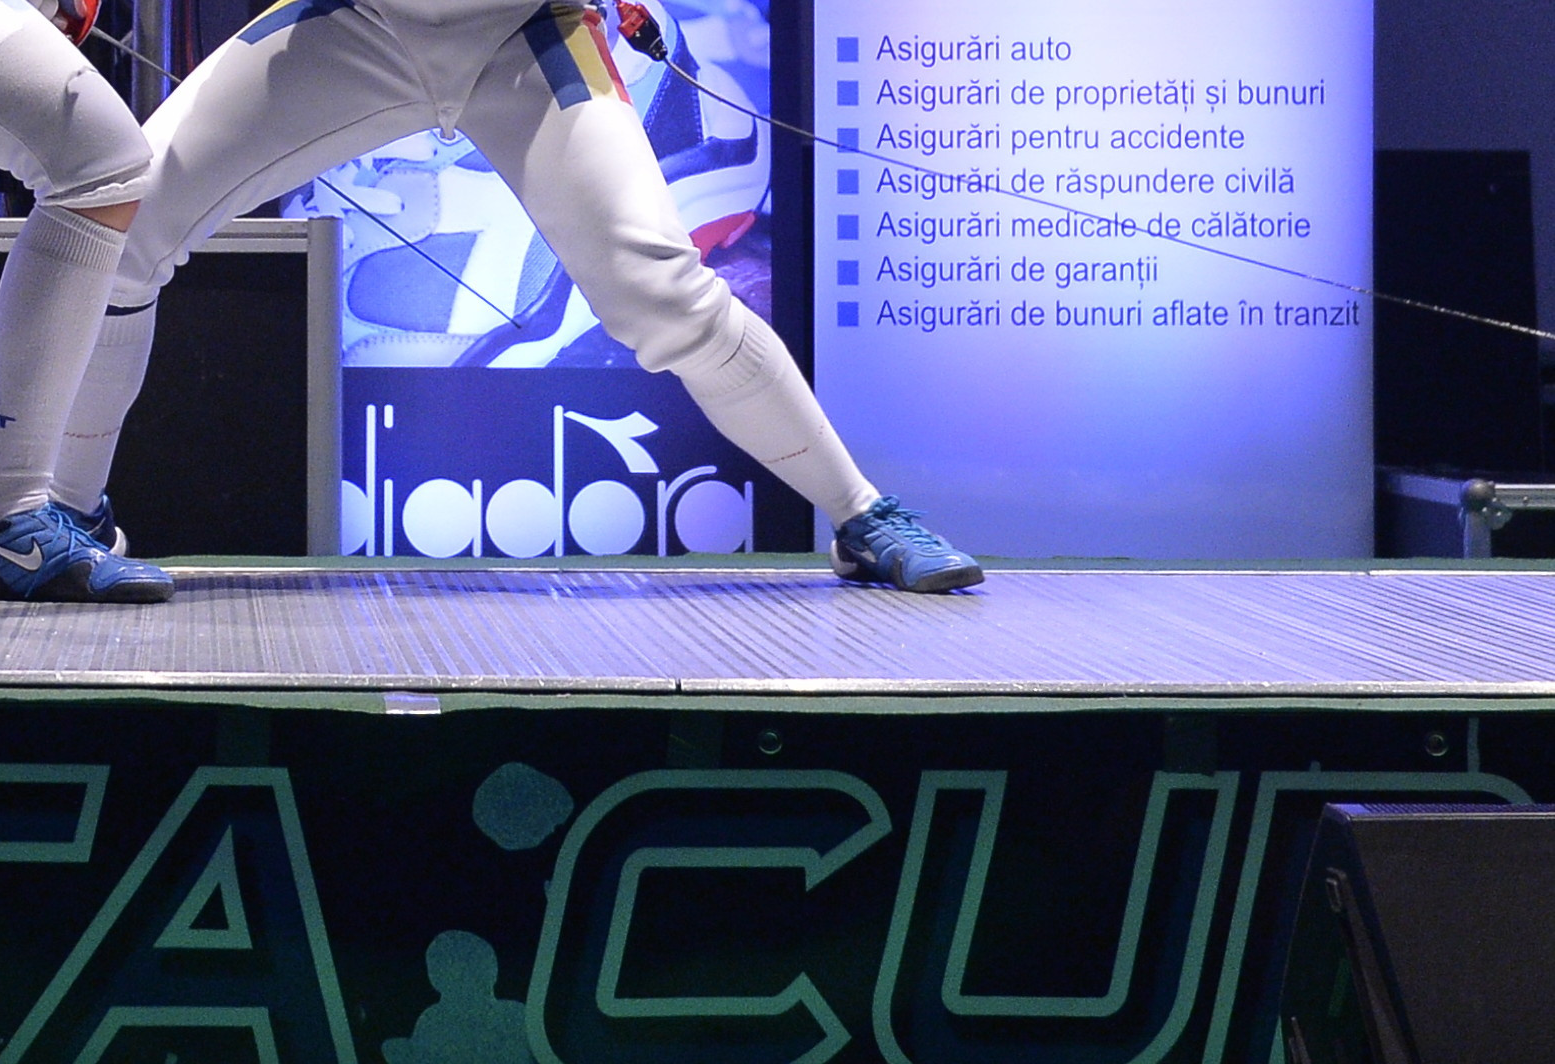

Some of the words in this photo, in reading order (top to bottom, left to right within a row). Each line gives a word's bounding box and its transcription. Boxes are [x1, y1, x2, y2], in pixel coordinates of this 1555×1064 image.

[876, 35, 1000, 67] Asigurări
[1011, 37, 1072, 61] auto
[876, 79, 1000, 112] Asigurări
[1011, 80, 1045, 105] de
[1056, 79, 1195, 112] proprietăți
[1206, 80, 1227, 113] și
[1238, 79, 1326, 105] bunuri
[876, 123, 1000, 156] Asigurări
[1011, 125, 1099, 156] pentru
[1110, 124, 1245, 149] accidente
[876, 166, 1000, 199] Asigurări
[1011, 168, 1045, 194] de
[1055, 168, 1215, 199] răspundere
[1225, 168, 1295, 194] civilă
[876, 211, 1000, 244] Asigurări
[1011, 211, 1137, 238] medicale
[1147, 212, 1181, 238] de
[1191, 212, 1312, 238] călătorie
[876, 255, 1000, 289] Asigurări
[1011, 256, 1045, 282] de
[1055, 256, 1158, 289] garanții
[876, 300, 1000, 333] Asigurări
[1011, 300, 1045, 326] de
[1055, 300, 1142, 326] bunuri
[1152, 300, 1229, 326] aflate
[1239, 300, 1264, 326] în
[1274, 298, 1360, 327] tranzit
